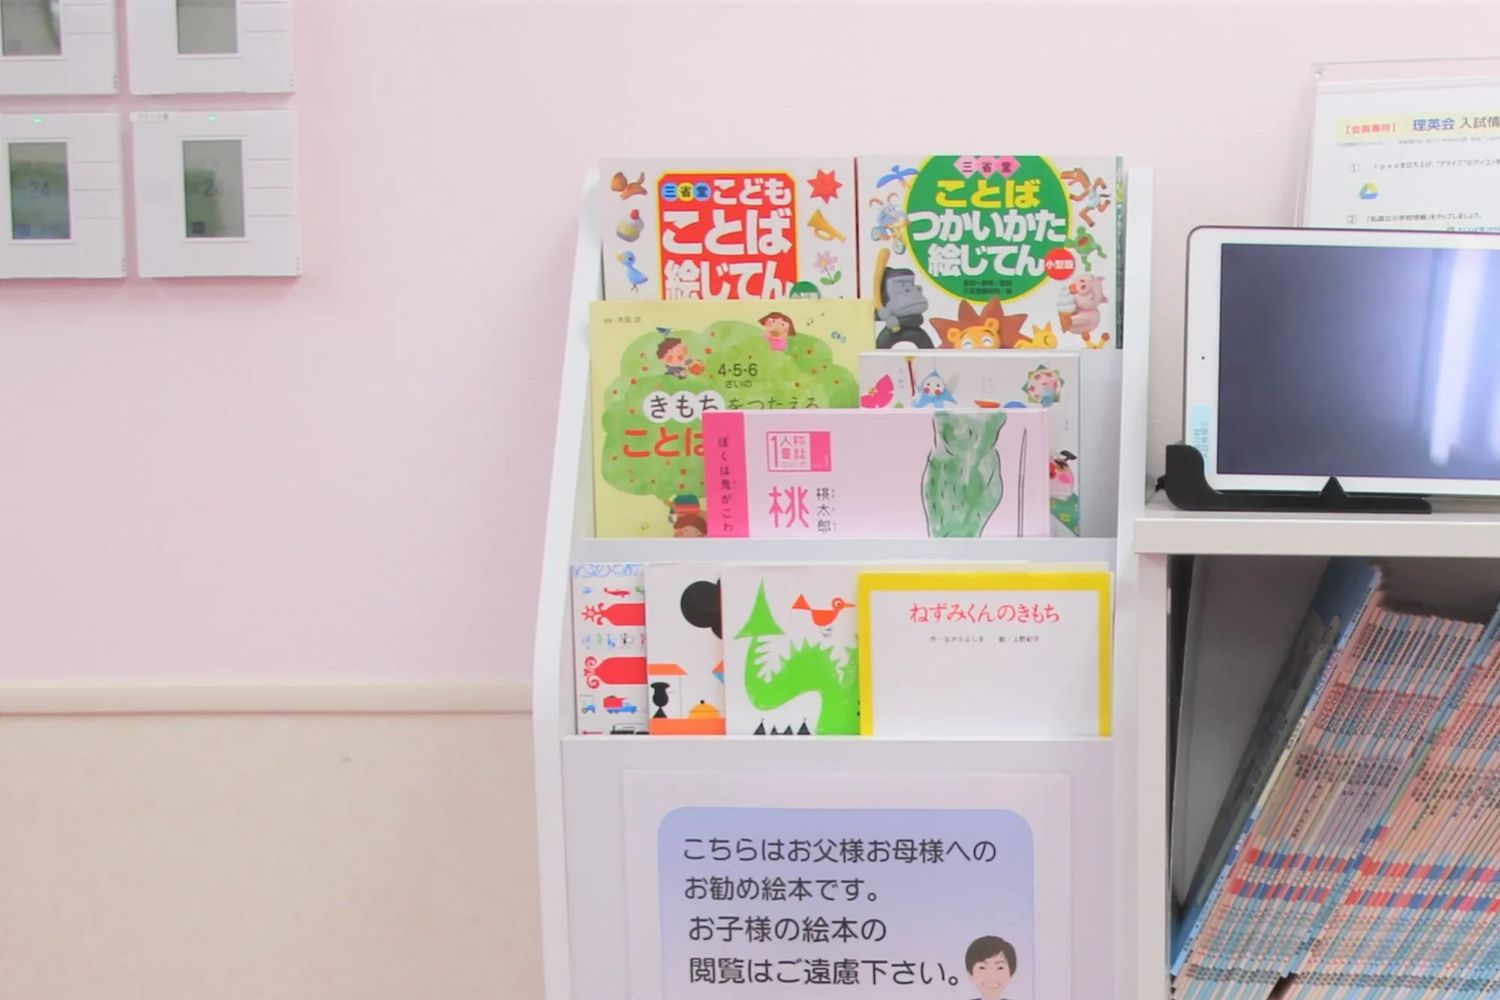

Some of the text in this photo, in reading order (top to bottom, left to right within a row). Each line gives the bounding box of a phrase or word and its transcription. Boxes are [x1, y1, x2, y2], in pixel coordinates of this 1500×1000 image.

[1412, 117, 1455, 132] 理英会
[713, 178, 791, 206] こども
[936, 179, 1041, 209] ことば
[662, 209, 793, 256] ことば
[908, 209, 1066, 243] つかいかた
[927, 243, 1045, 278] 絵じてん
[665, 259, 794, 300] 絵じてん
[768, 486, 810, 529] 桃
[816, 487, 832, 534] 桃太郎
[909, 602, 1060, 624] ねずみくんのきもち
[683, 836, 997, 865] こちらはお父様お母様への
[684, 876, 879, 902] お勧め絵本です。
[688, 916, 887, 943] お子様の絵本の
[688, 958, 961, 986] 閲覧はご遠慮下さい。
